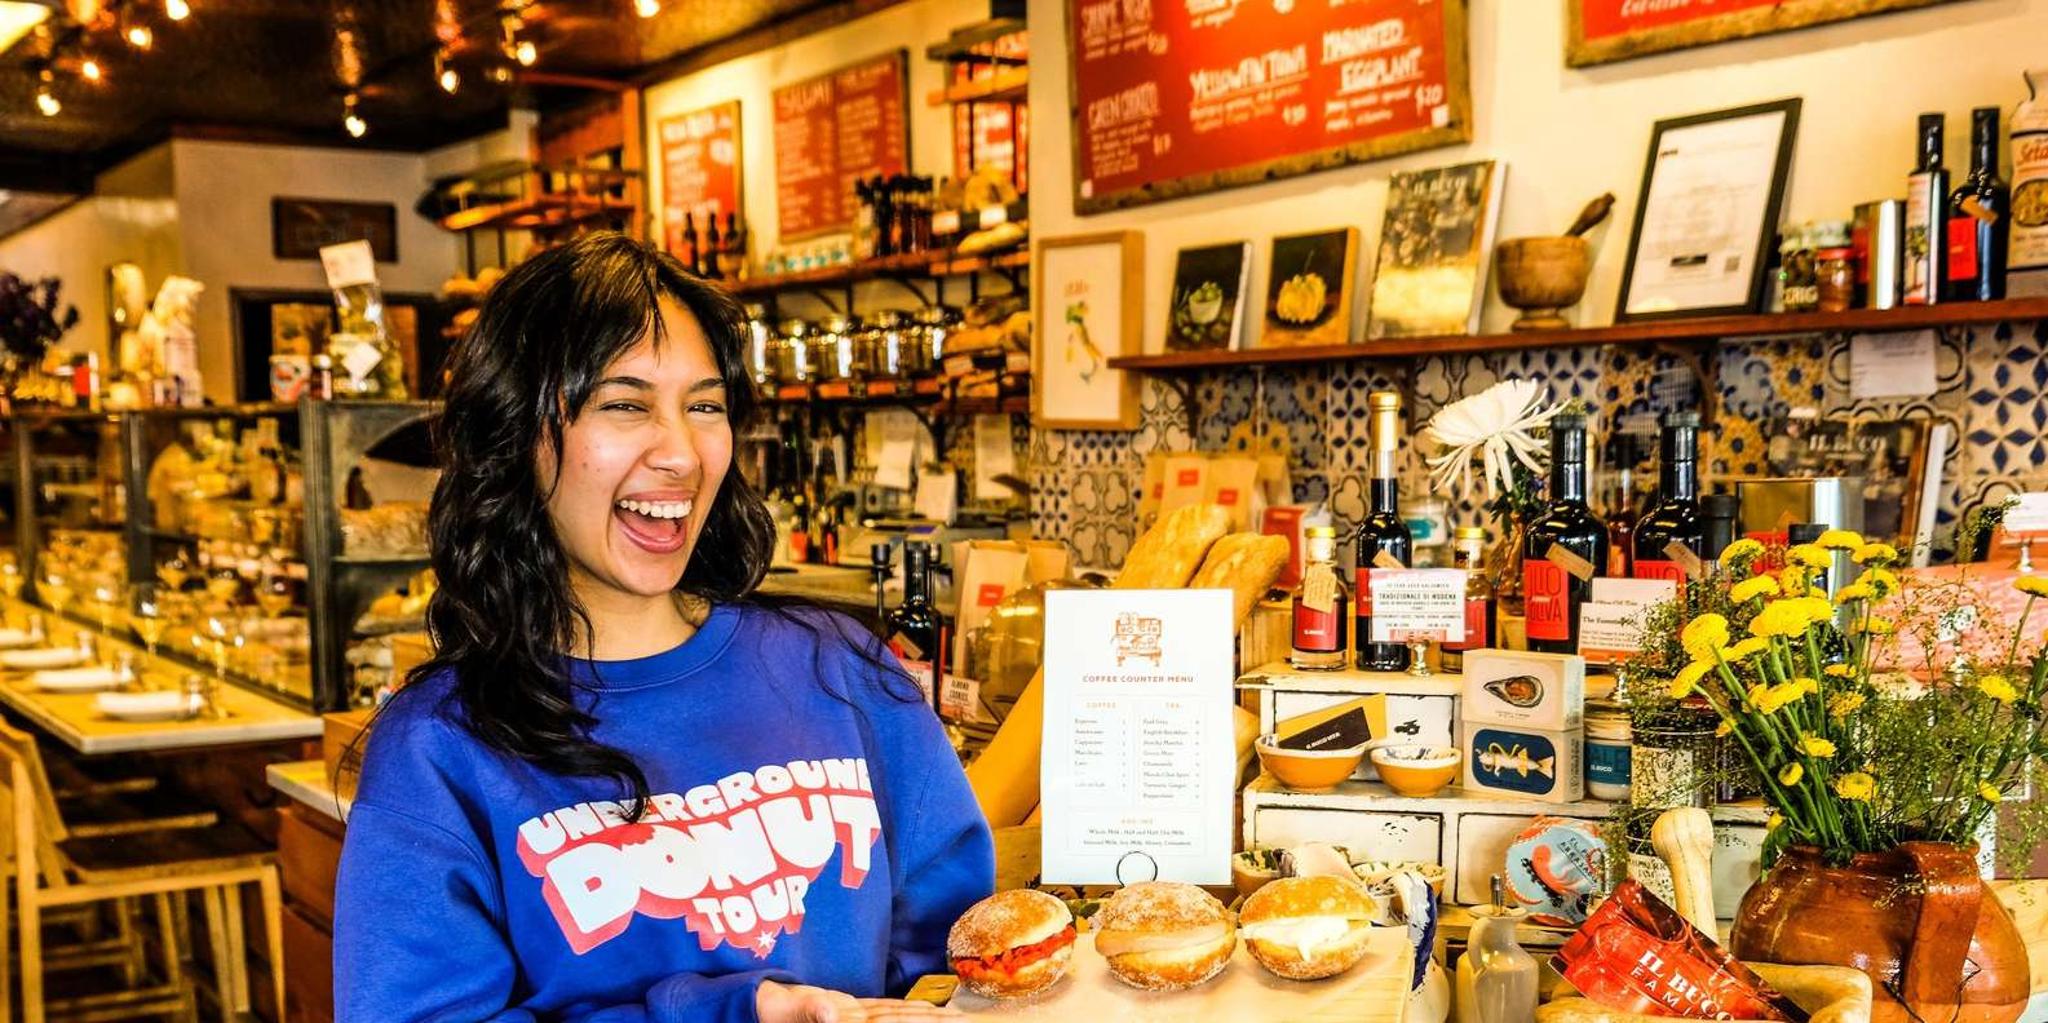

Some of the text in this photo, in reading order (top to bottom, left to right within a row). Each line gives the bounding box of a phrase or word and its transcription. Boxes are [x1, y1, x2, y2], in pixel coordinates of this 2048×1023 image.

[1340, 46, 1423, 92] EGGPLANT
[1083, 675, 1194, 683] COFFEE COUNTER MENU
[545, 794, 882, 934] DONUT
[692, 875, 810, 933] TOUR
[1638, 949, 1665, 979] IL
[1630, 964, 1702, 1019] FAMI
